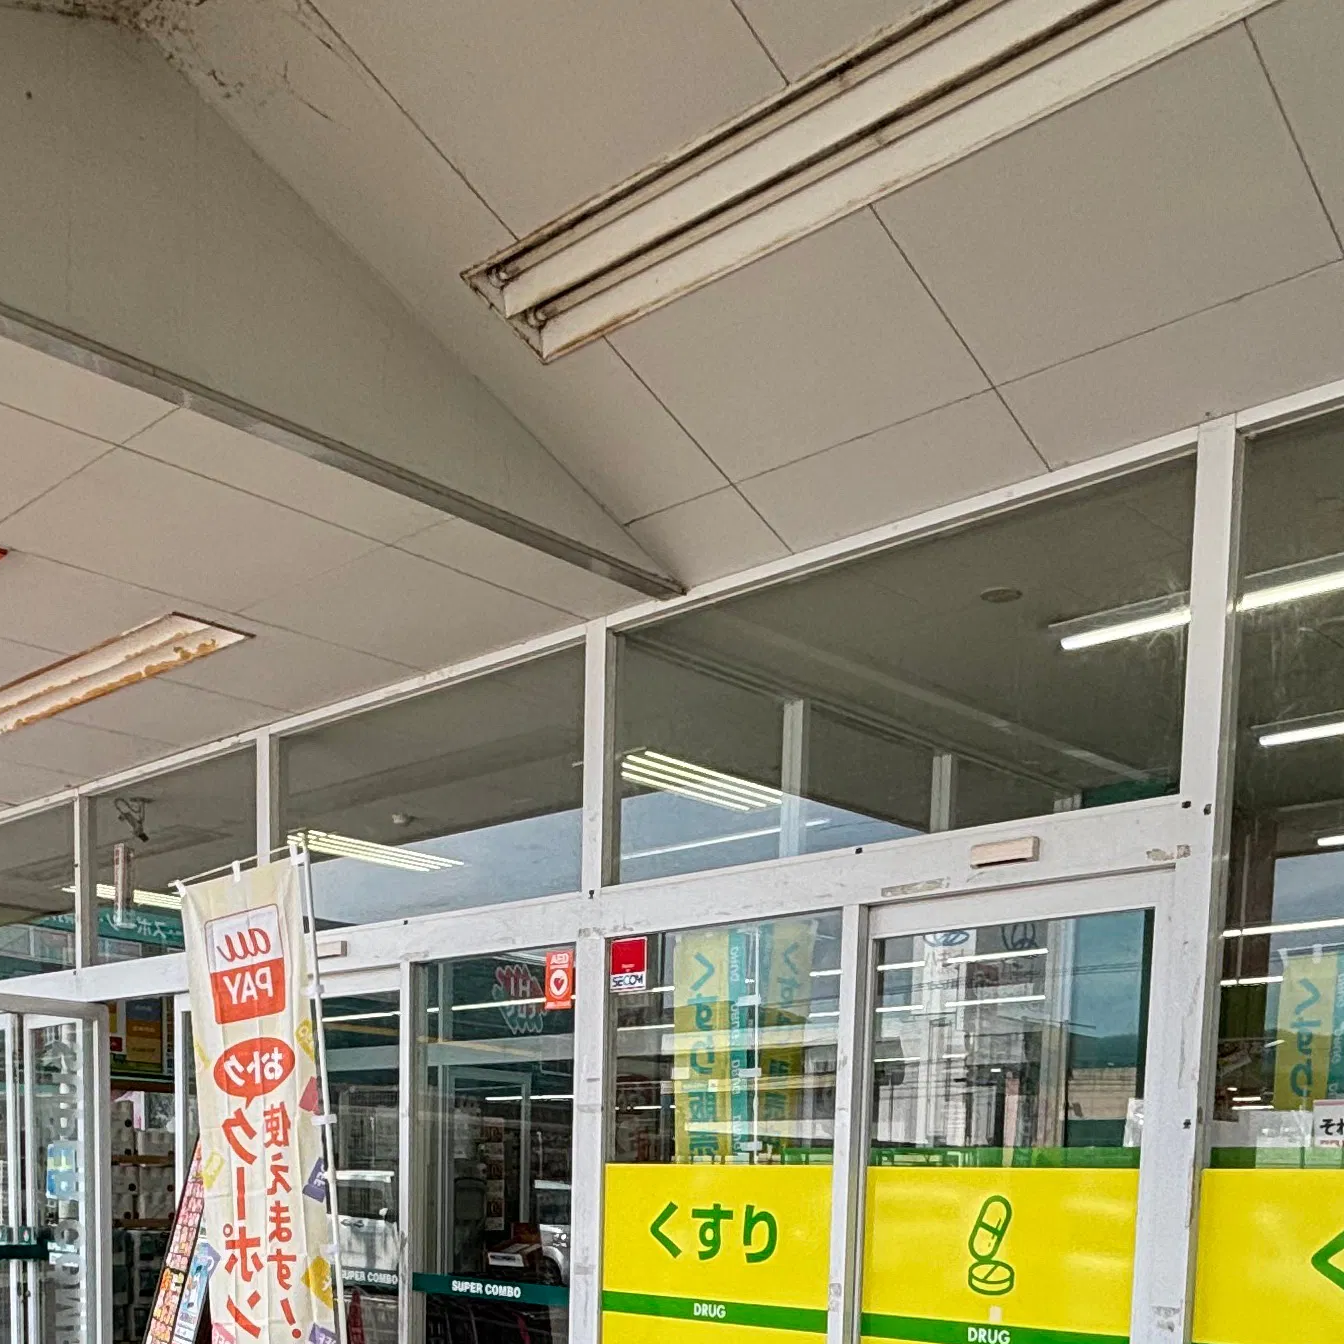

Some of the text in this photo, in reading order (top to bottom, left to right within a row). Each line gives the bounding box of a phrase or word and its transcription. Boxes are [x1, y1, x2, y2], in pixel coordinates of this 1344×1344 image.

[550, 953, 569, 965] AED
[612, 974, 644, 988] SECOM
[650, 1202, 779, 1263] くすり
[367, 1272, 398, 1285] COMBO
[451, 1280, 521, 1299] SUPER COMBO
[693, 1302, 727, 1320] DRUG
